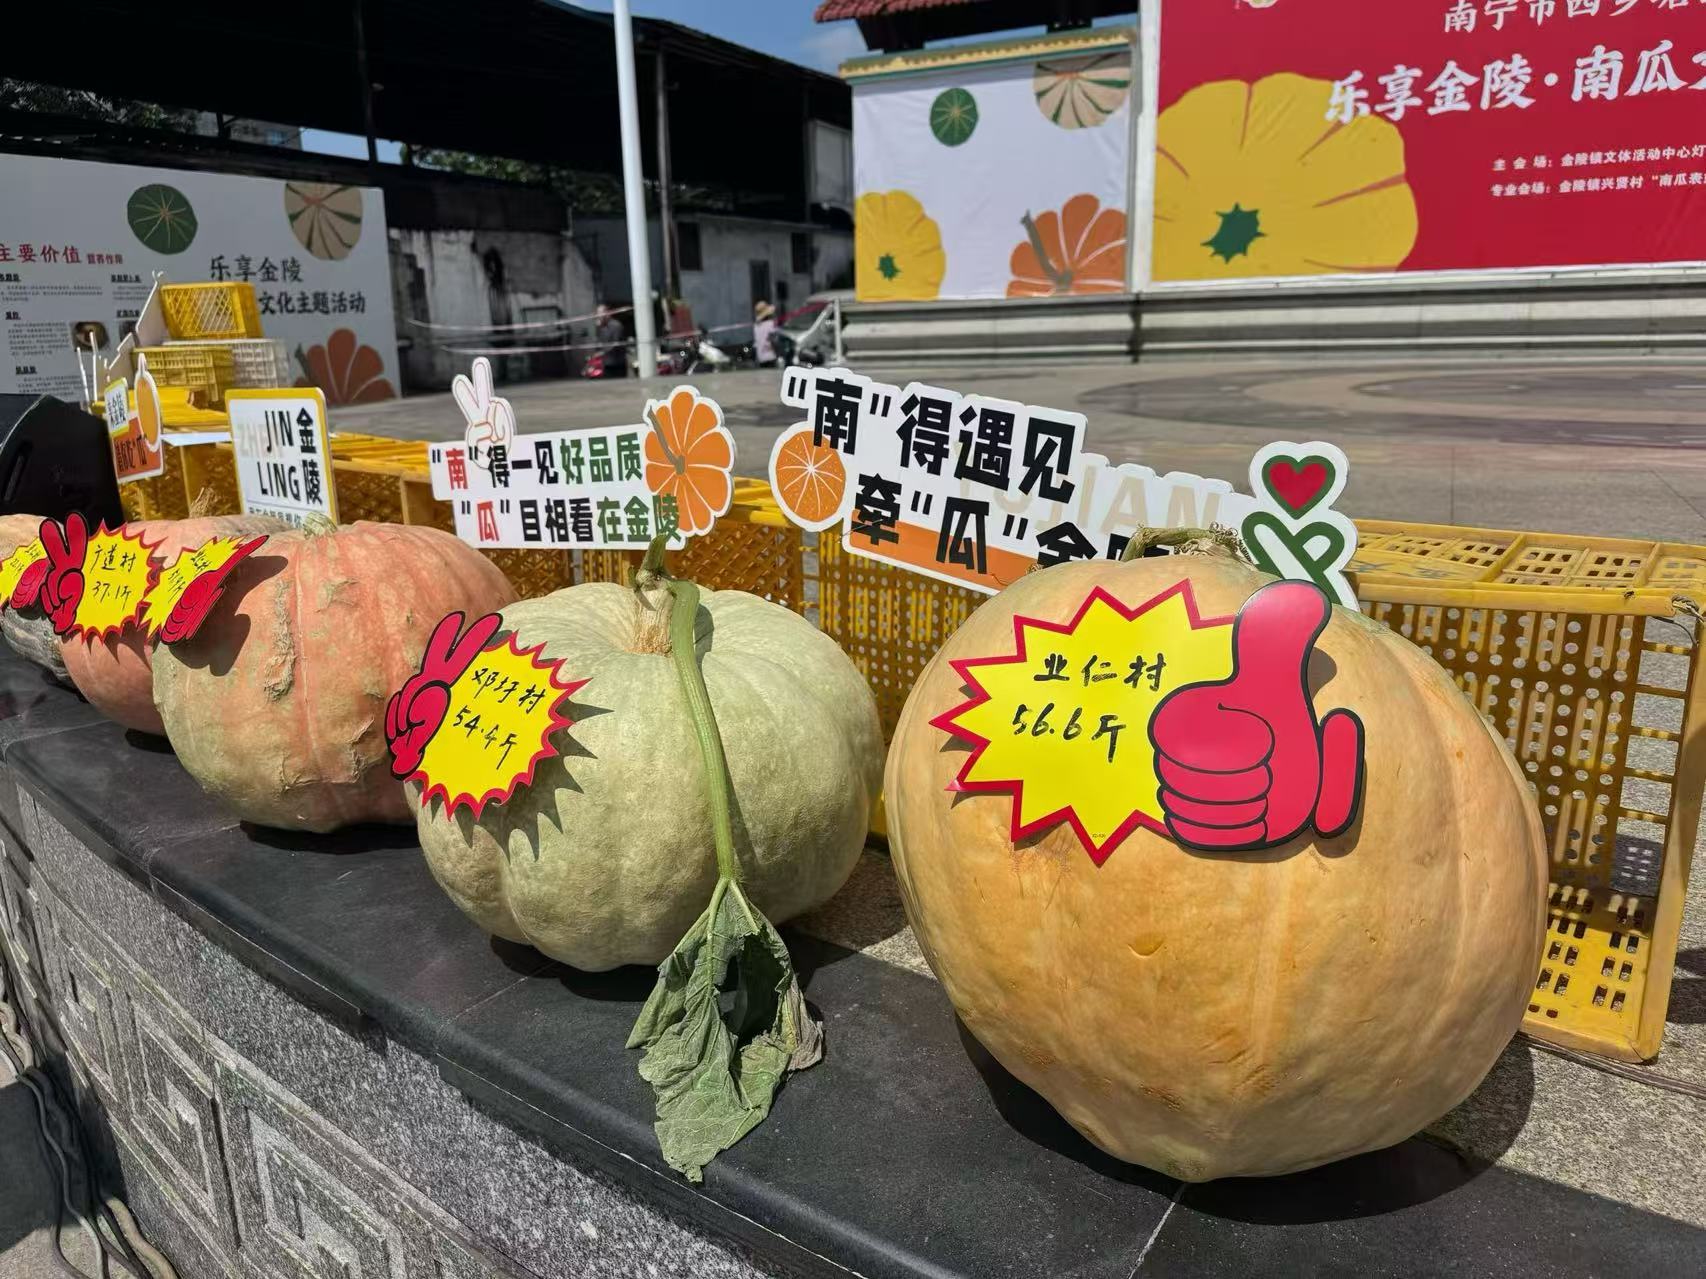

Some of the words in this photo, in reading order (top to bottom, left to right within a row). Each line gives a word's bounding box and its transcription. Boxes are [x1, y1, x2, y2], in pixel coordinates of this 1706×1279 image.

[1444, 0, 1689, 33] 南宁市西
[0, 244, 82, 264] 主要价值
[210, 255, 303, 283] 乐享金陵
[265, 410, 294, 453] JIN
[257, 461, 301, 501] LING
[431, 432, 642, 490] "南"得一见好品质
[461, 493, 682, 544] "瓜"目相看在金陵
[1033, 652, 1167, 692] 业仁村
[452, 704, 518, 771] 54.4斤
[1012, 702, 1127, 764] 56.6斤
